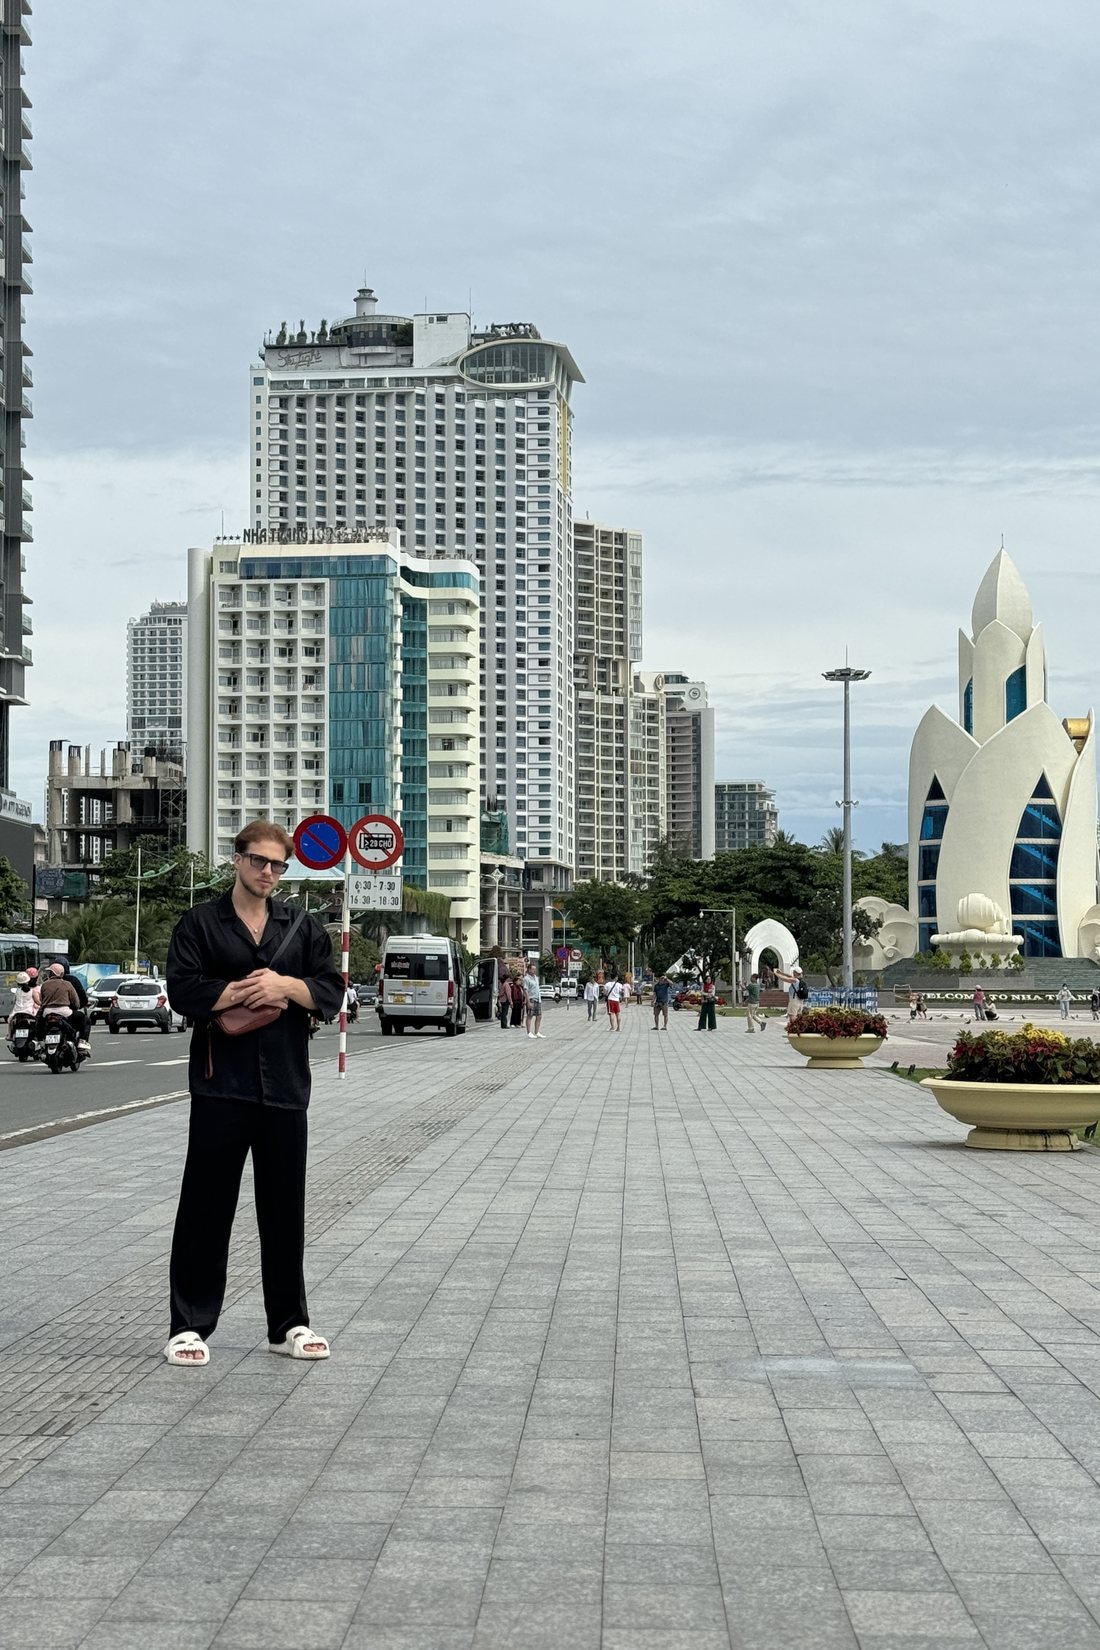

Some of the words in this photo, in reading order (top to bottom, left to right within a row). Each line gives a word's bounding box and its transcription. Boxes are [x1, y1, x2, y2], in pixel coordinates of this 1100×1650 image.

[243, 528, 267, 544] NHA
[350, 895, 371, 905] 16:30
[379, 896, 399, 906] 18:30
[921, 992, 975, 1000] ELCOM
